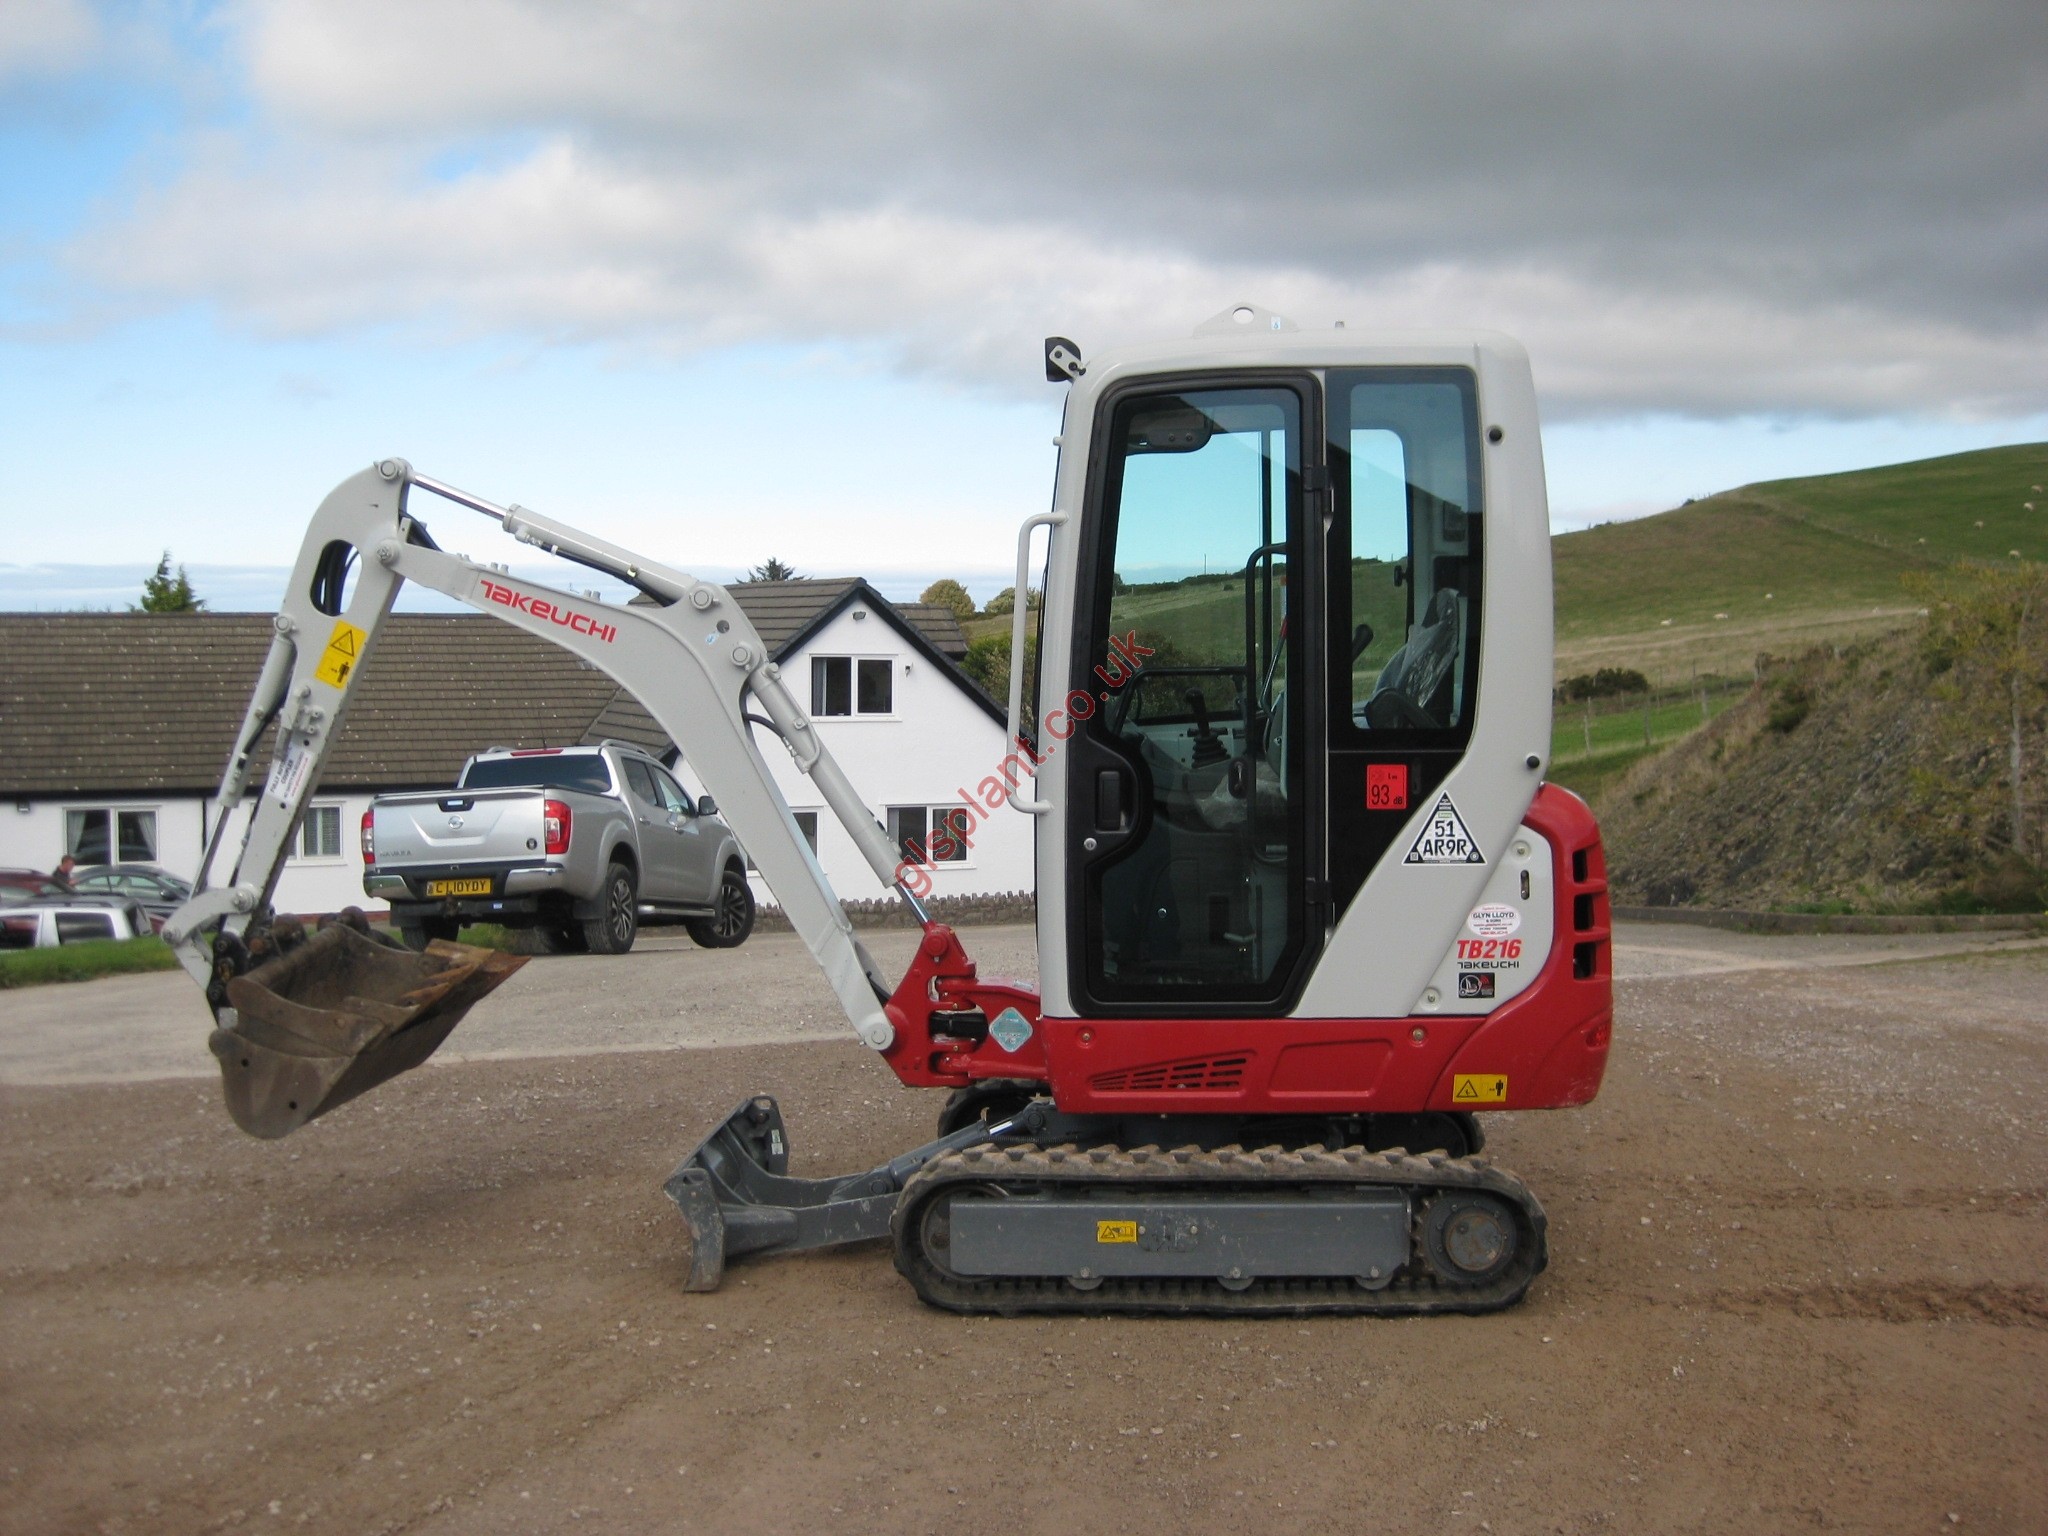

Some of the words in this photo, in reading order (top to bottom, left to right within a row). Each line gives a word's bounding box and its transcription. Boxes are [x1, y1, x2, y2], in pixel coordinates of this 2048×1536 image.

[1371, 784, 1390, 805] 93
[1435, 820, 1456, 838] 51
[1423, 838, 1468, 857] AR9R
[1457, 939, 1522, 959] TB216
